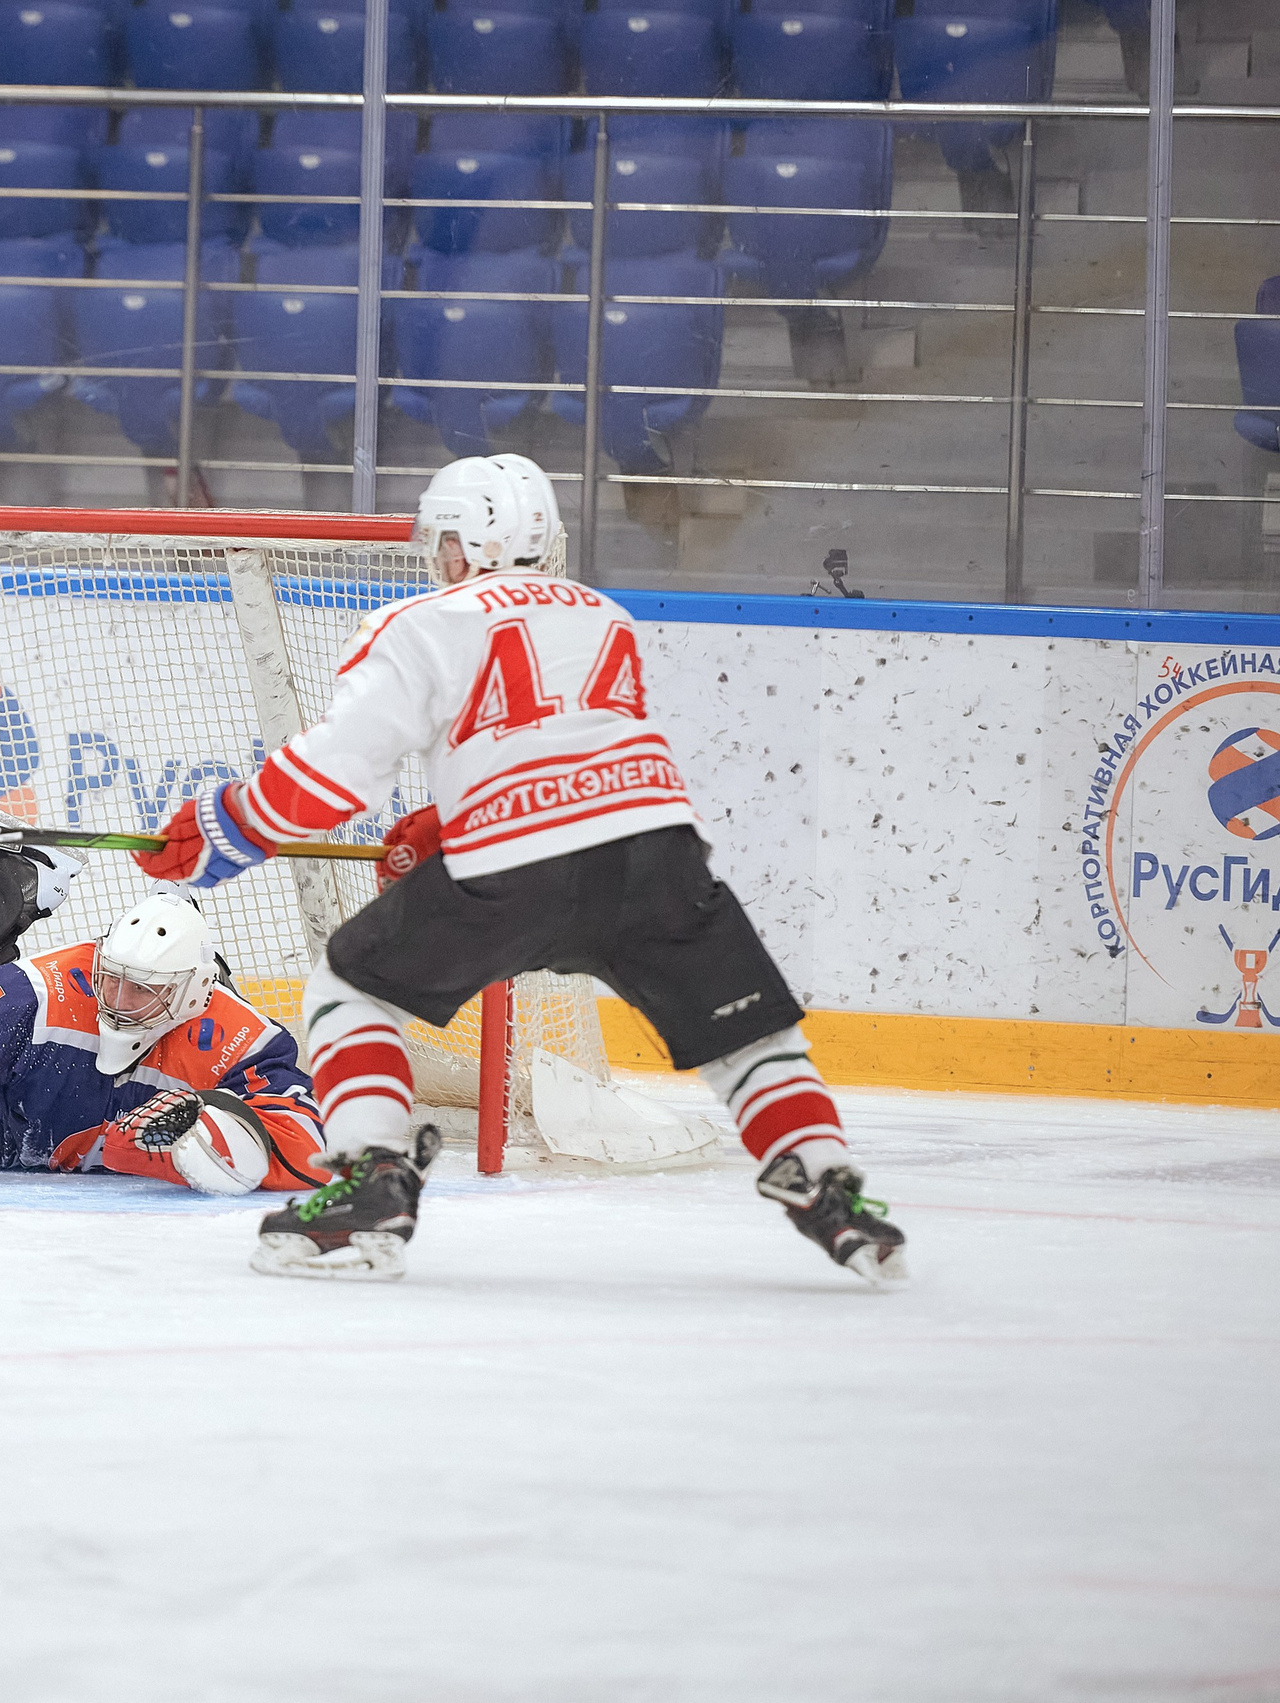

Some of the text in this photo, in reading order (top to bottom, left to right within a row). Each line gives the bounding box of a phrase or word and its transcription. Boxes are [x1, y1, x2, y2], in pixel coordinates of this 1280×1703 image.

[476, 582, 601, 614] ЛЬВОВ
[448, 617, 647, 749] 44
[1157, 655, 1182, 679] 54
[1081, 650, 1280, 959] КОРПОРАТИВНАЯ ХОККЕЙНА
[210, 1026, 251, 1076] РусГидро
